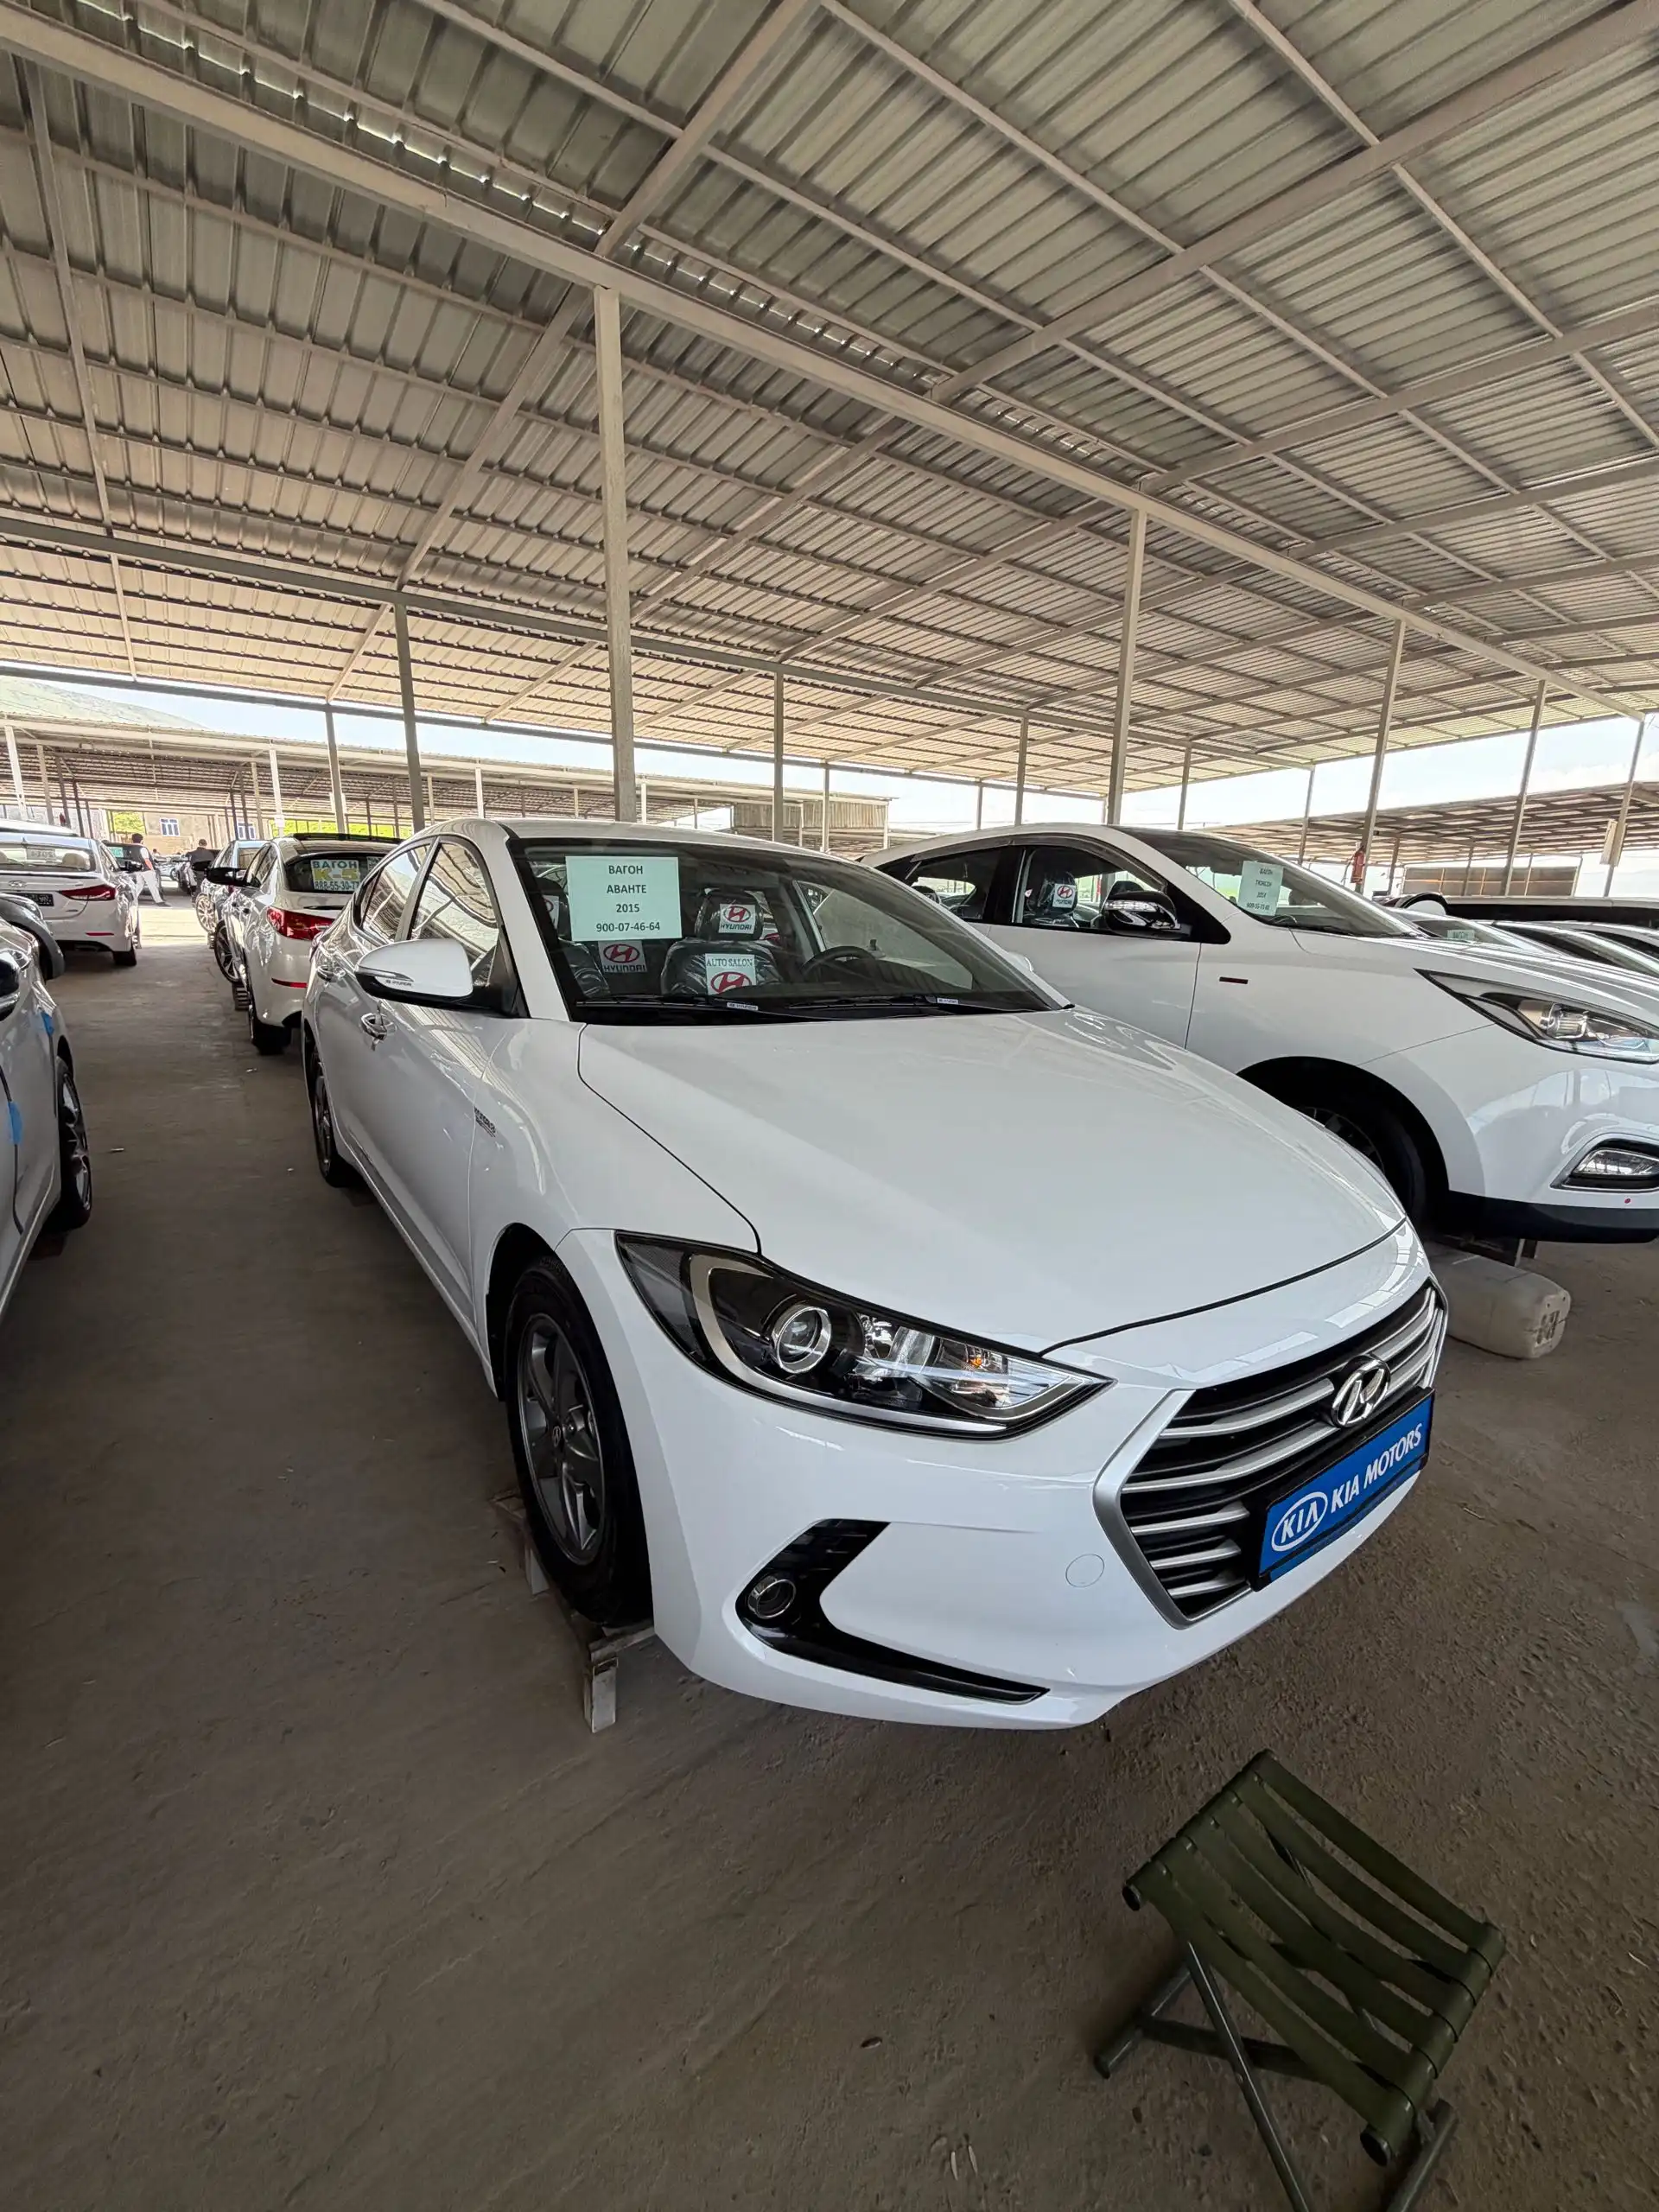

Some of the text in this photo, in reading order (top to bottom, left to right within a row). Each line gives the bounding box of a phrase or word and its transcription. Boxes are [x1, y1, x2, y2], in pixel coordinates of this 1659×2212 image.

[608, 865, 644, 874] ВАГОН
[607, 884, 647, 893] АВАНТЕ
[615, 904, 640, 913] 2015
[595, 922, 661, 932] 900-07-46-64
[706, 958, 753, 967] AUTO SALON
[1331, 1423, 1423, 1514] KIA MOTORS
[1281, 1501, 1319, 1544] KIA
